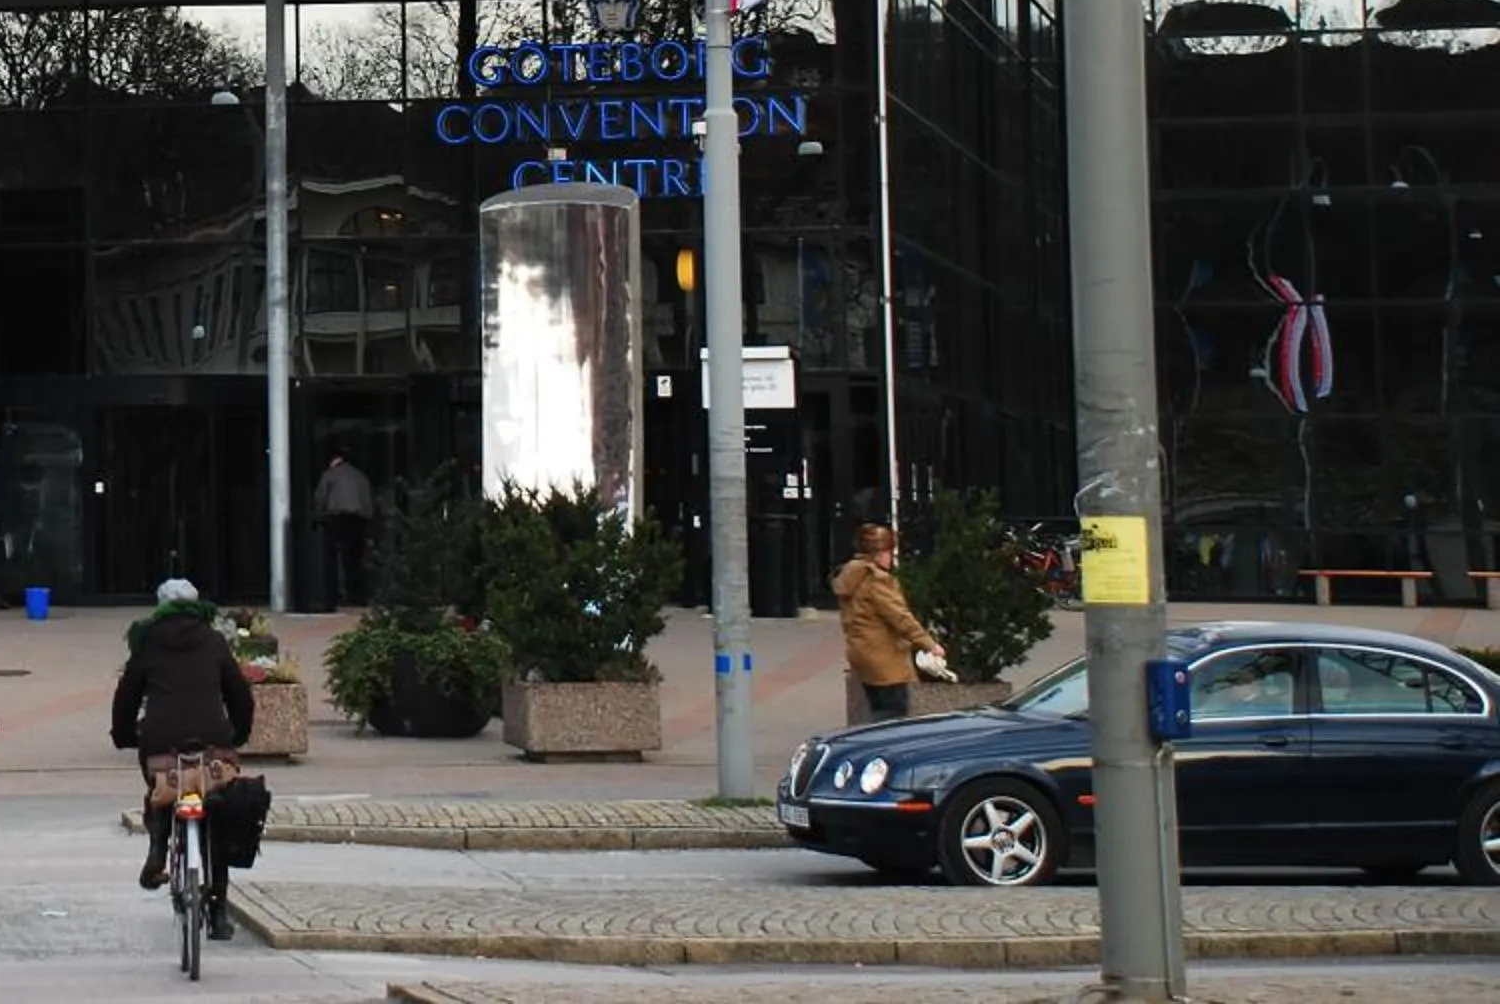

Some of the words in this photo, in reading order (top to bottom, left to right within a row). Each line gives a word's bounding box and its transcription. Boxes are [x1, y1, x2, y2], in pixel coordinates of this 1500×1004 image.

[468, 35, 772, 85] GÖTEBOG
[436, 94, 806, 144] CONVENTON
[513, 158, 708, 196] CENTR
